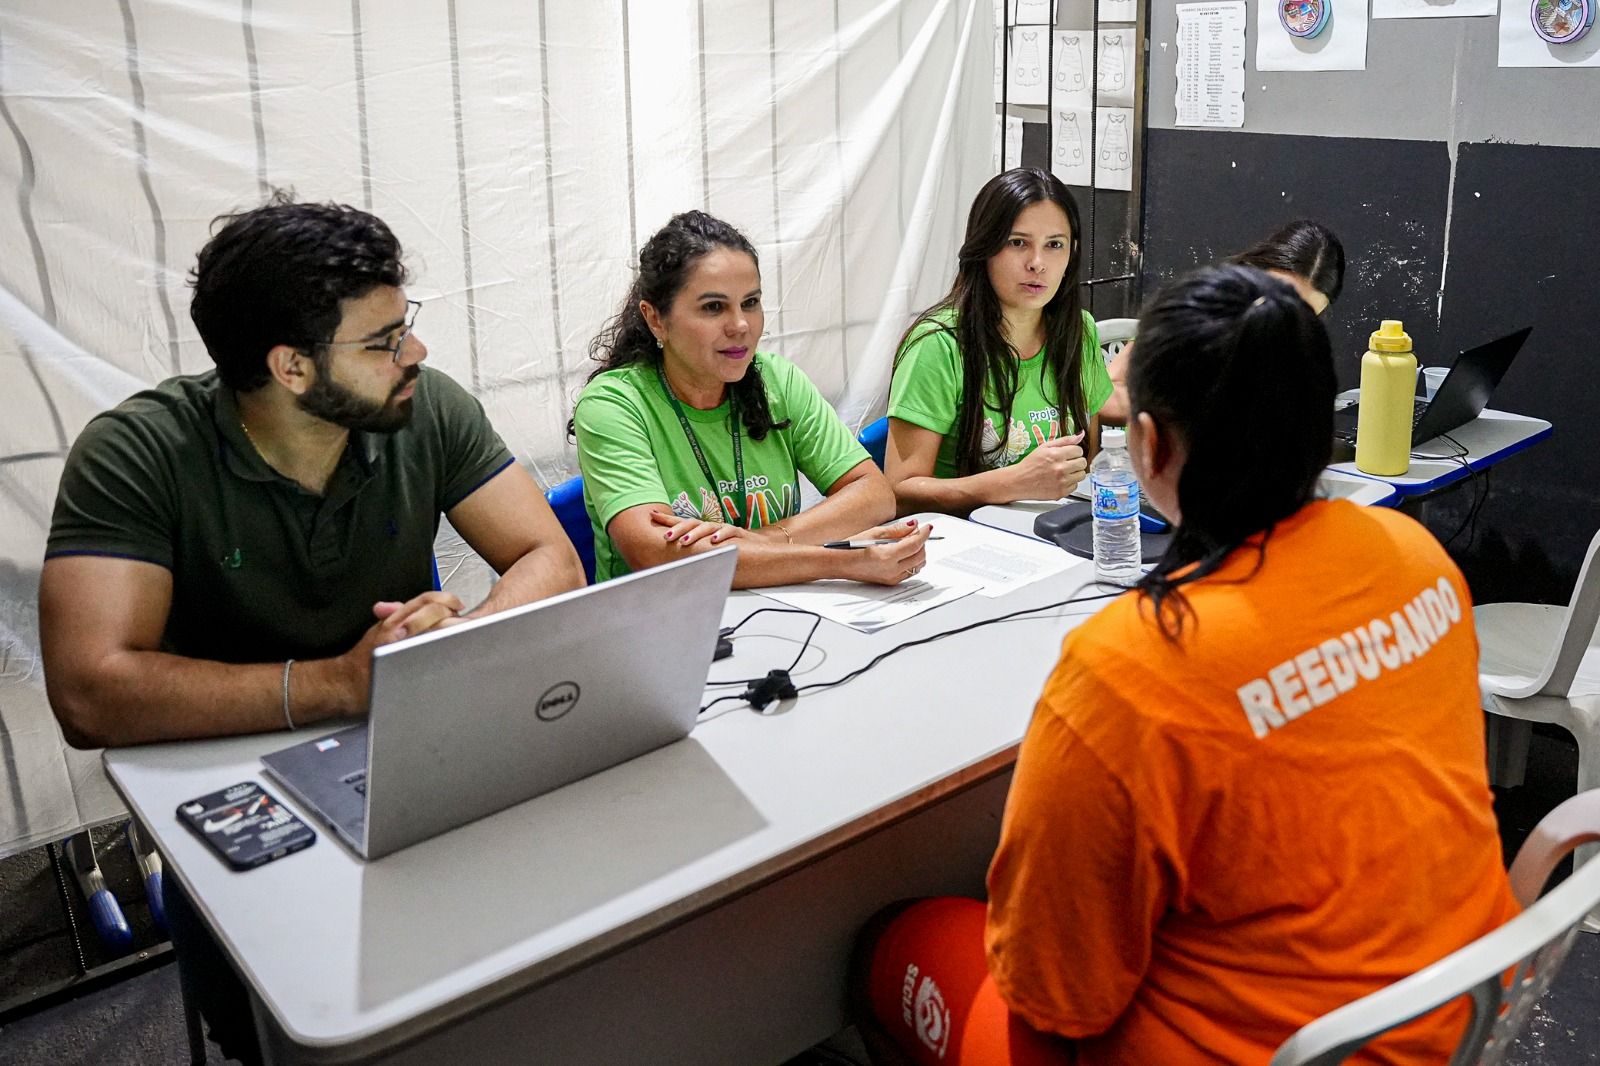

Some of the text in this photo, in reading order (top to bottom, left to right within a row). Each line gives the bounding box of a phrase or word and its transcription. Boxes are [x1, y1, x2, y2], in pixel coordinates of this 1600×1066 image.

[1029, 407, 1057, 421] Proje
[719, 476, 767, 492] Proeto
[1237, 576, 1461, 739] REEDUCANDO
[541, 692, 573, 710] DELL
